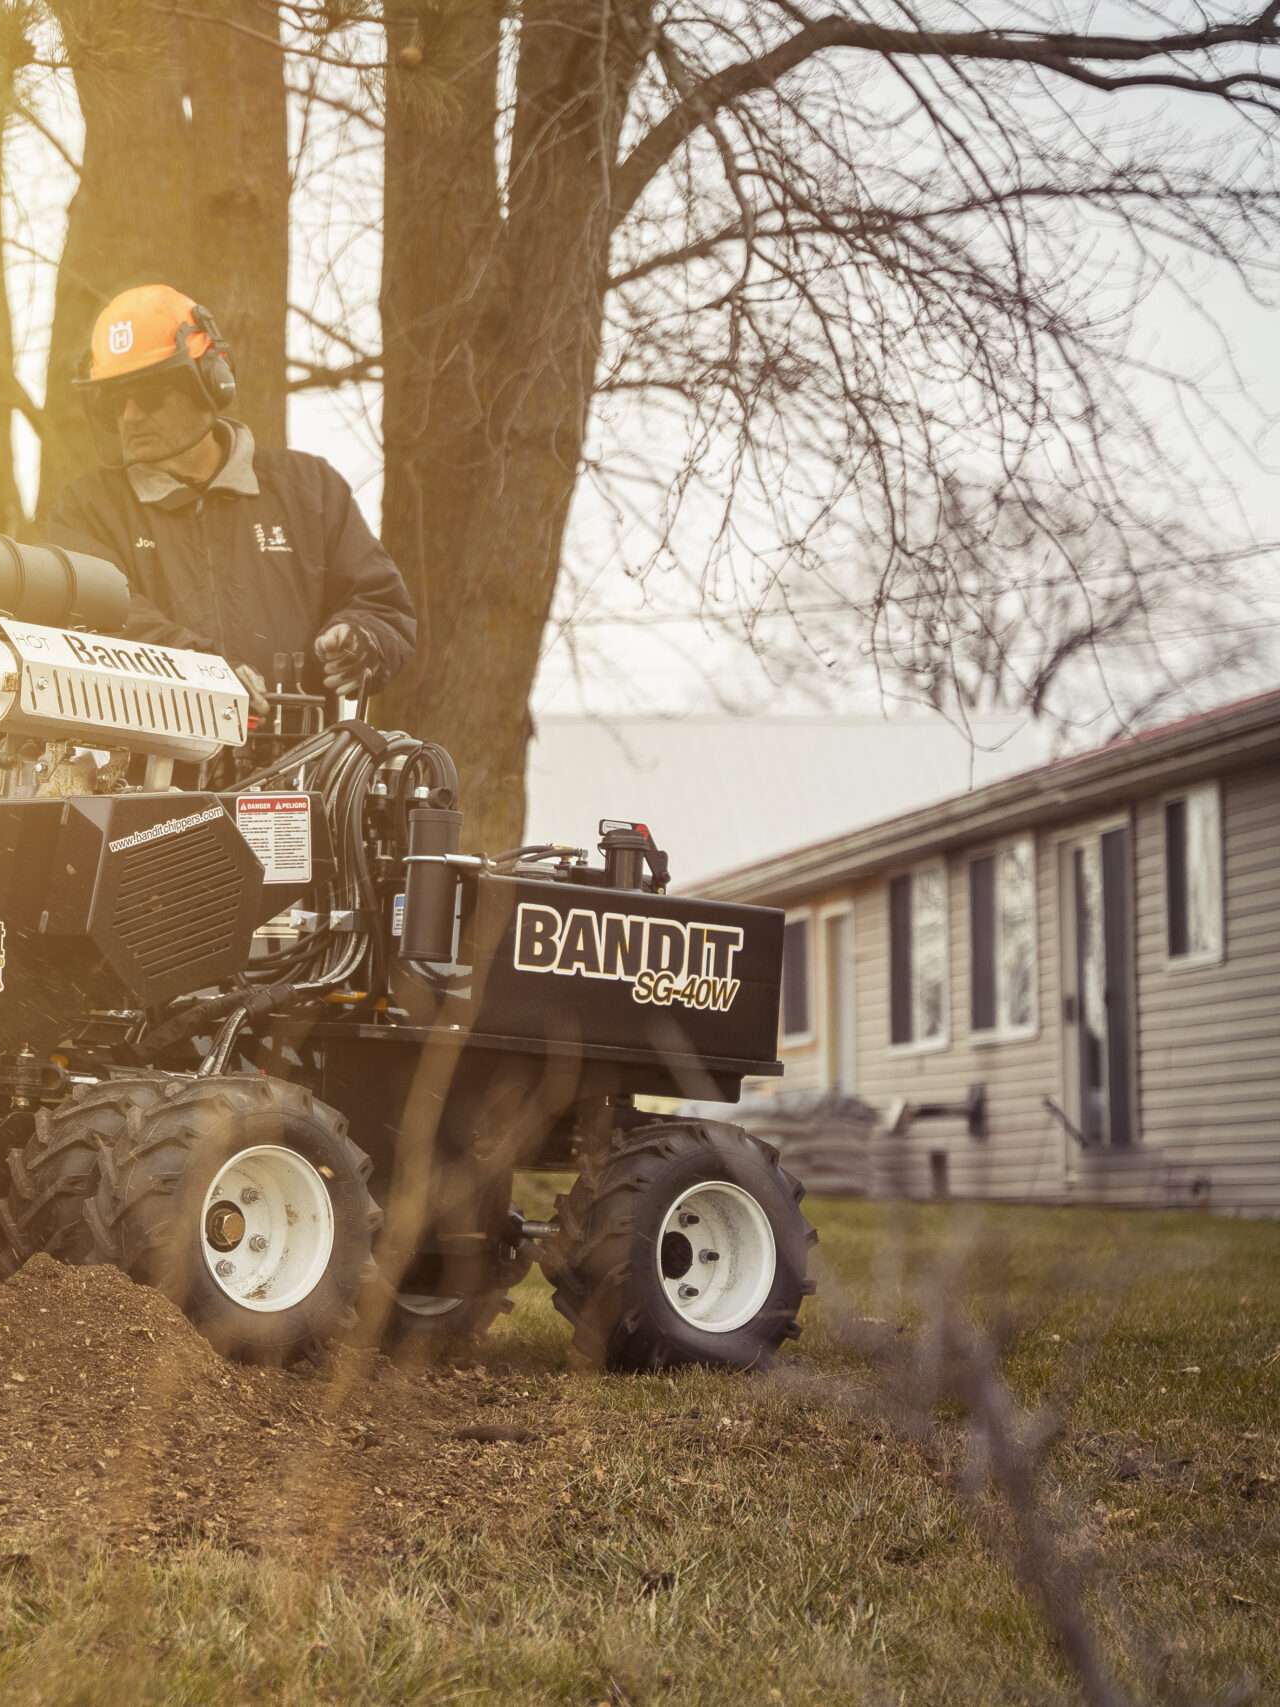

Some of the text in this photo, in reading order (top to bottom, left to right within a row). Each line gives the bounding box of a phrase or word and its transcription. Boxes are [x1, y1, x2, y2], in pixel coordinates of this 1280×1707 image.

[15, 633, 50, 651] HOT
[62, 633, 187, 681] Bandit
[198, 664, 233, 681] HOT
[109, 807, 224, 852] www.banditchippers.com
[515, 904, 743, 981] BANDIT
[633, 970, 740, 1011] SG-40W
